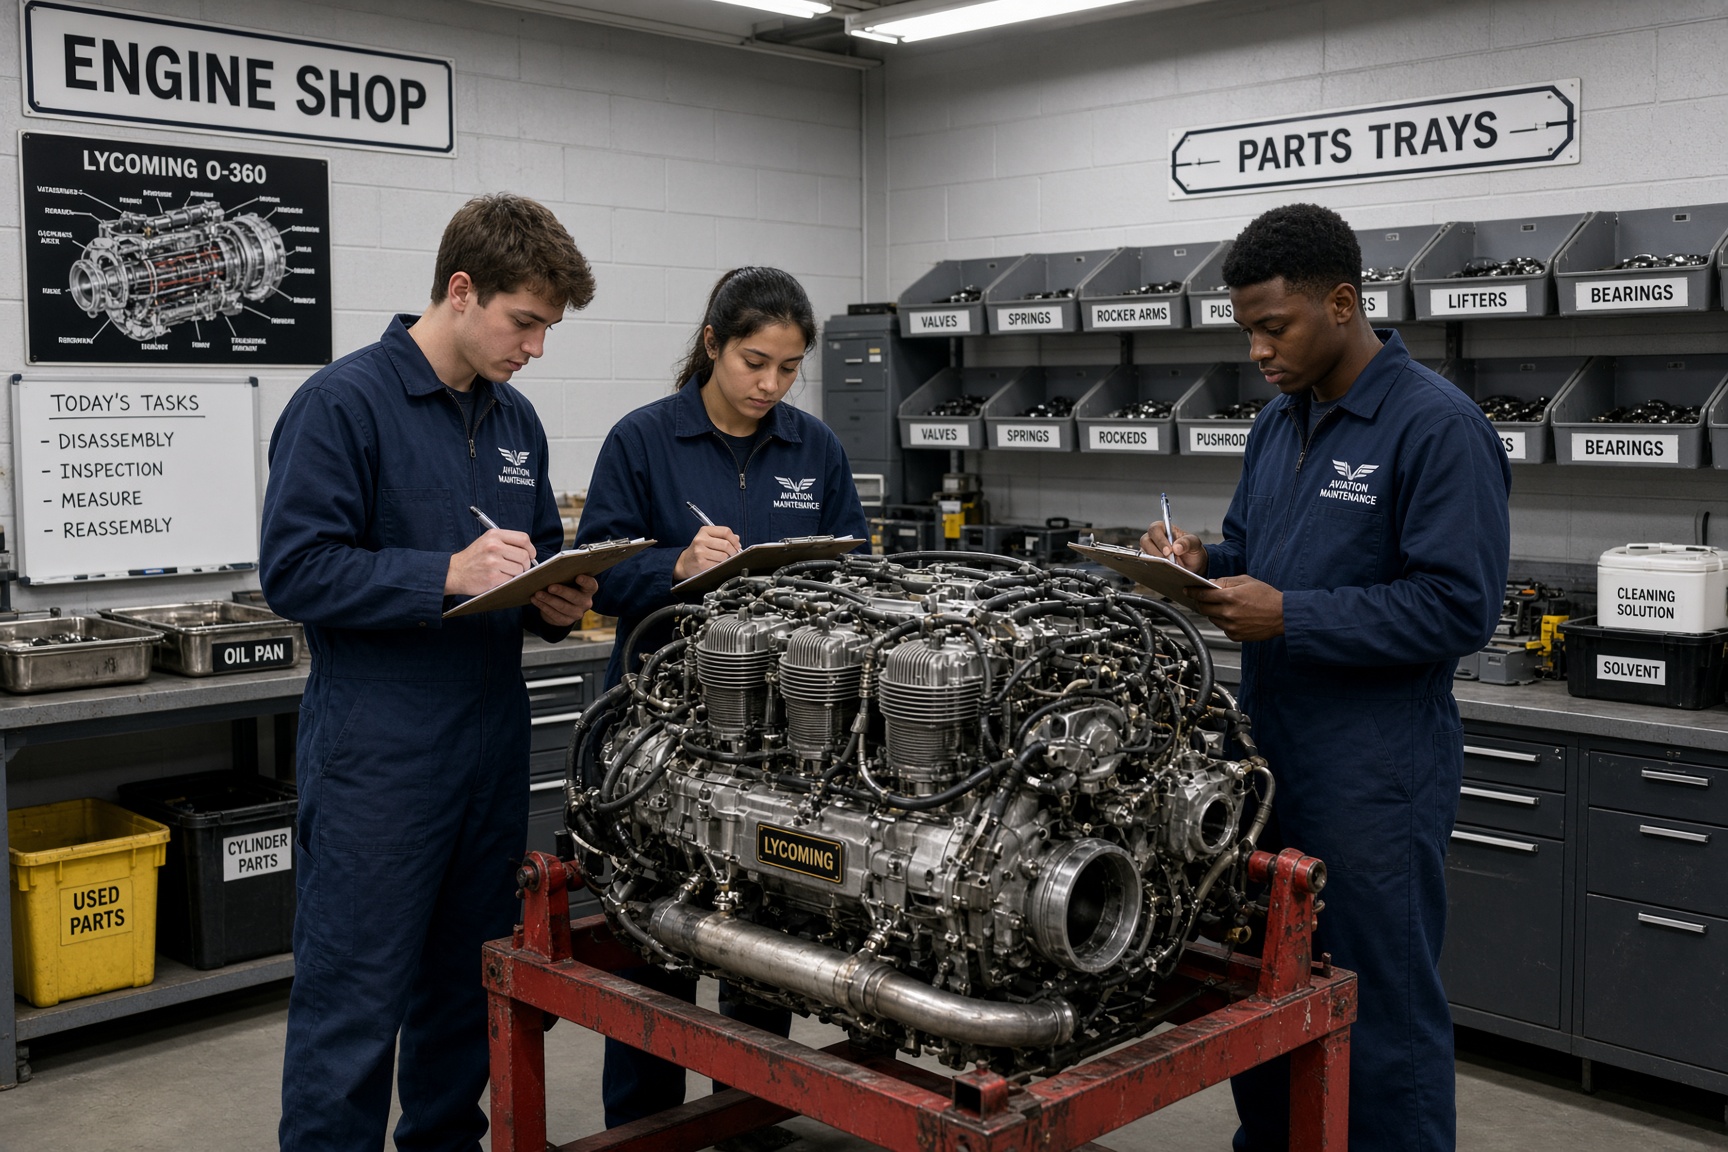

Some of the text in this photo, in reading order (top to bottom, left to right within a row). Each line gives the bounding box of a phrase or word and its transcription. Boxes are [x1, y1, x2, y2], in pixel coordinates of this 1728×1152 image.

[63, 33, 427, 126] ENGINE SHOP
[1238, 110, 1498, 173] PARTS TRAYS
[83, 149, 267, 184] LYCOMING O-360
[1448, 292, 1508, 309] LIFTERS
[1591, 284, 1674, 303] BEARINGS
[921, 314, 958, 328] VALVES
[1008, 311, 1051, 326] SPRINGS
[1097, 307, 1168, 322] ROCKER ARMS
[50, 392, 200, 412] TODAY'S TASKS
[58, 431, 174, 450] DISASSEMBLY
[921, 428, 958, 441] VALVES
[1007, 429, 1050, 443] SPRINGS
[1099, 430, 1147, 445] ROCKEDS
[1585, 439, 1664, 457] BEARINGS
[60, 461, 163, 480] INSPECTION
[1328, 480, 1369, 493] AVIATION
[61, 490, 143, 509] MEASURE
[1319, 488, 1377, 506] MAINTENANCE
[63, 517, 172, 539] REASSEMBLY
[1617, 587, 1676, 603] CLEANING
[1617, 603, 1675, 620] SOLUTION
[224, 643, 284, 665] OIL PAN
[1603, 660, 1660, 679] SOLVENT
[227, 832, 288, 856] CYLINDER
[764, 836, 834, 871] LYCOMING
[238, 852, 278, 873] PARTS
[73, 885, 120, 911] USED
[70, 908, 125, 936] PARTS
